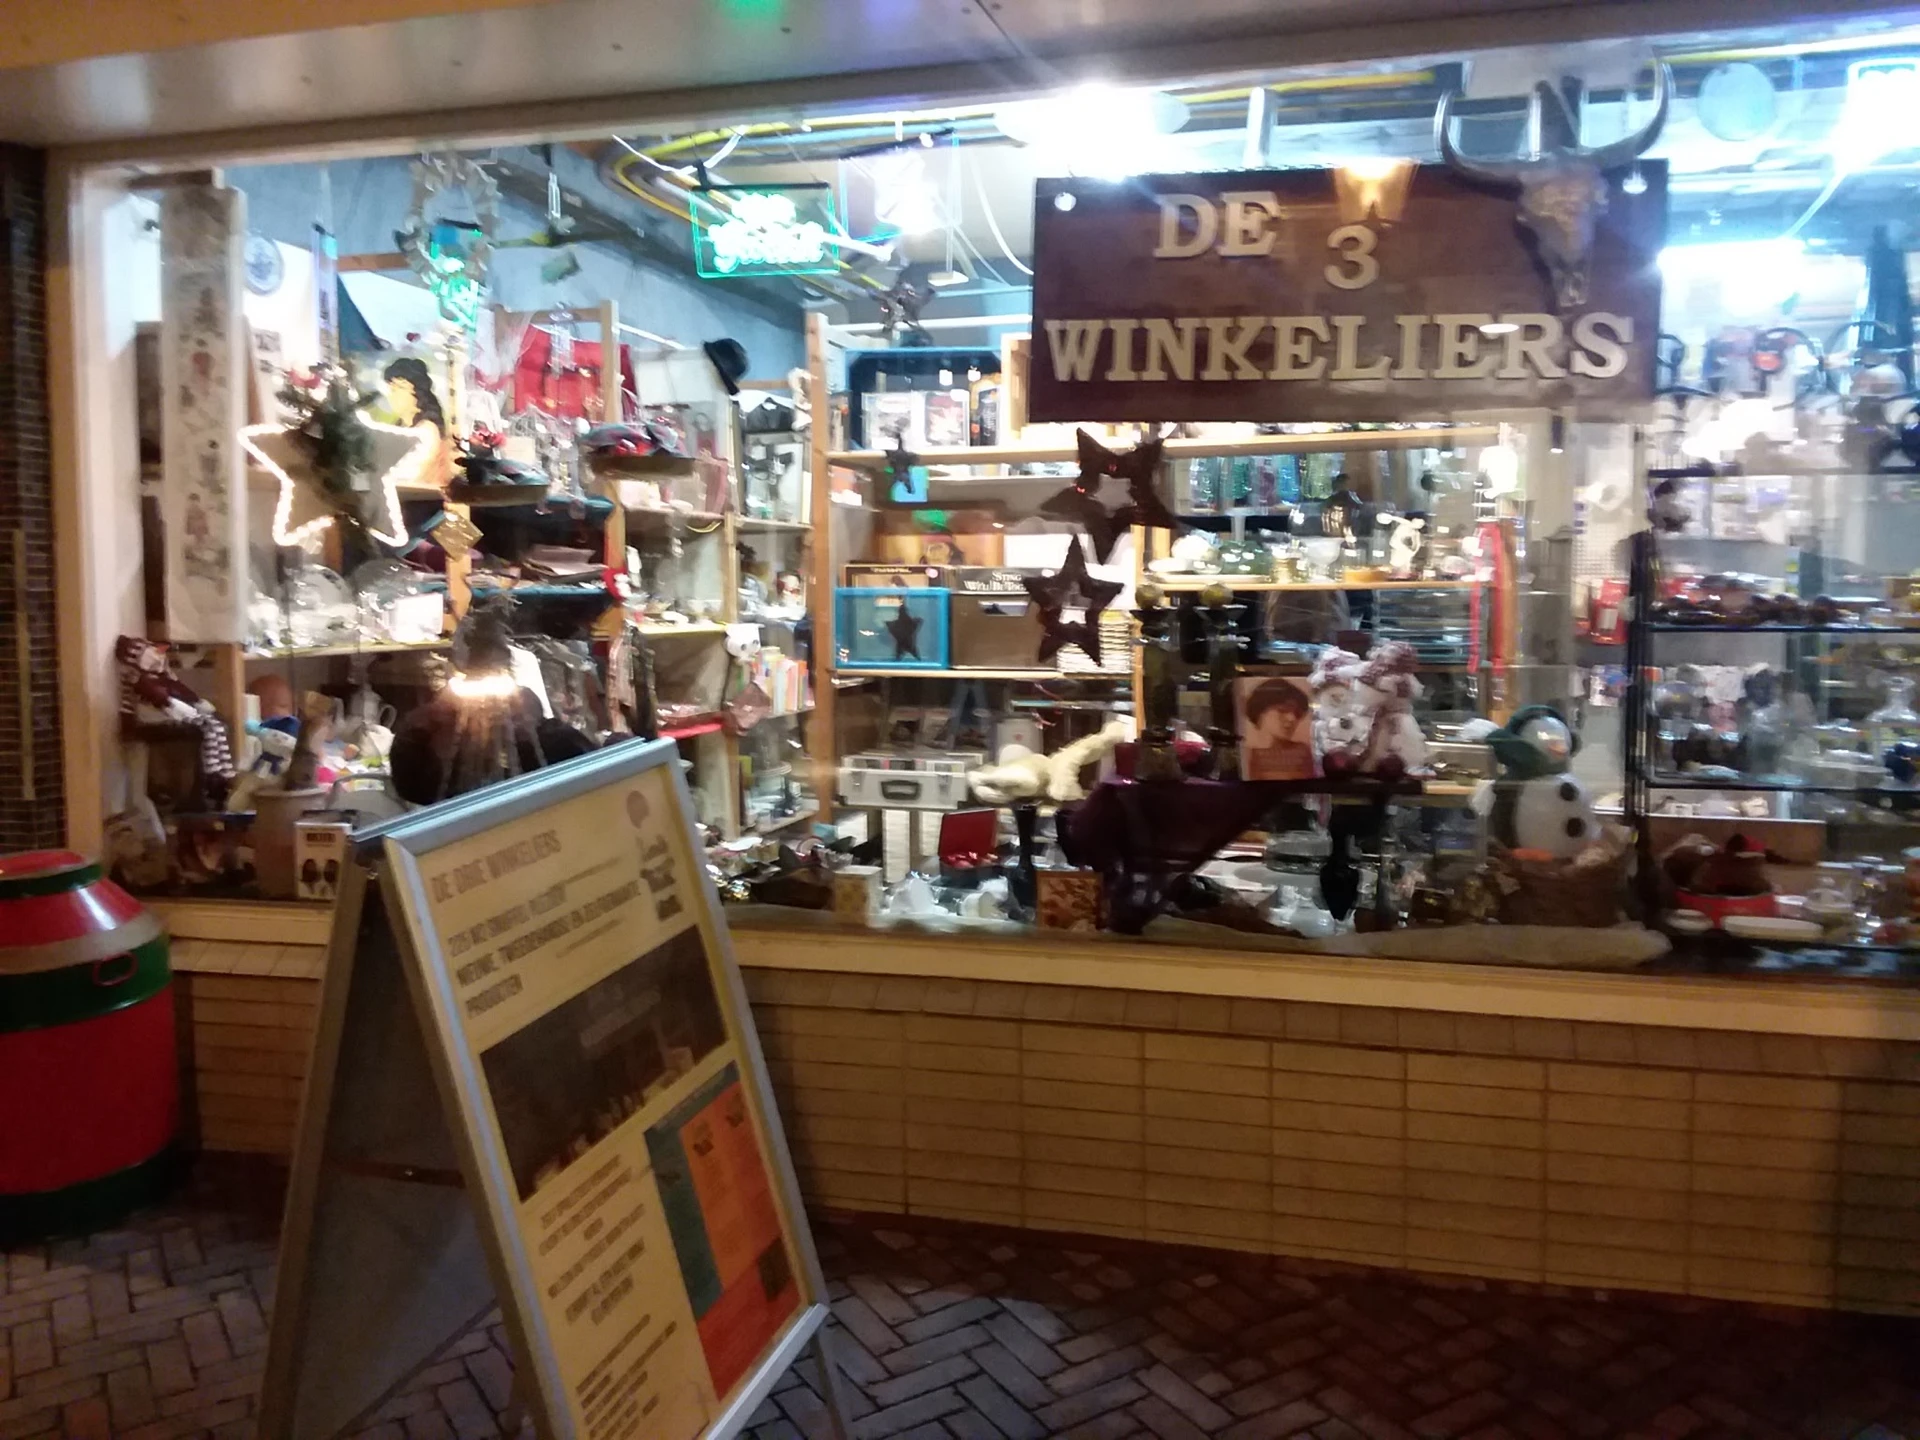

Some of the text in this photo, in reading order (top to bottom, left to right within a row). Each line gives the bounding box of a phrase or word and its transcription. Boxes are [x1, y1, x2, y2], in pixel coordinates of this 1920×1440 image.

[1154, 190, 1380, 290] DE 3
[1044, 311, 1635, 382] WINKELIERS
